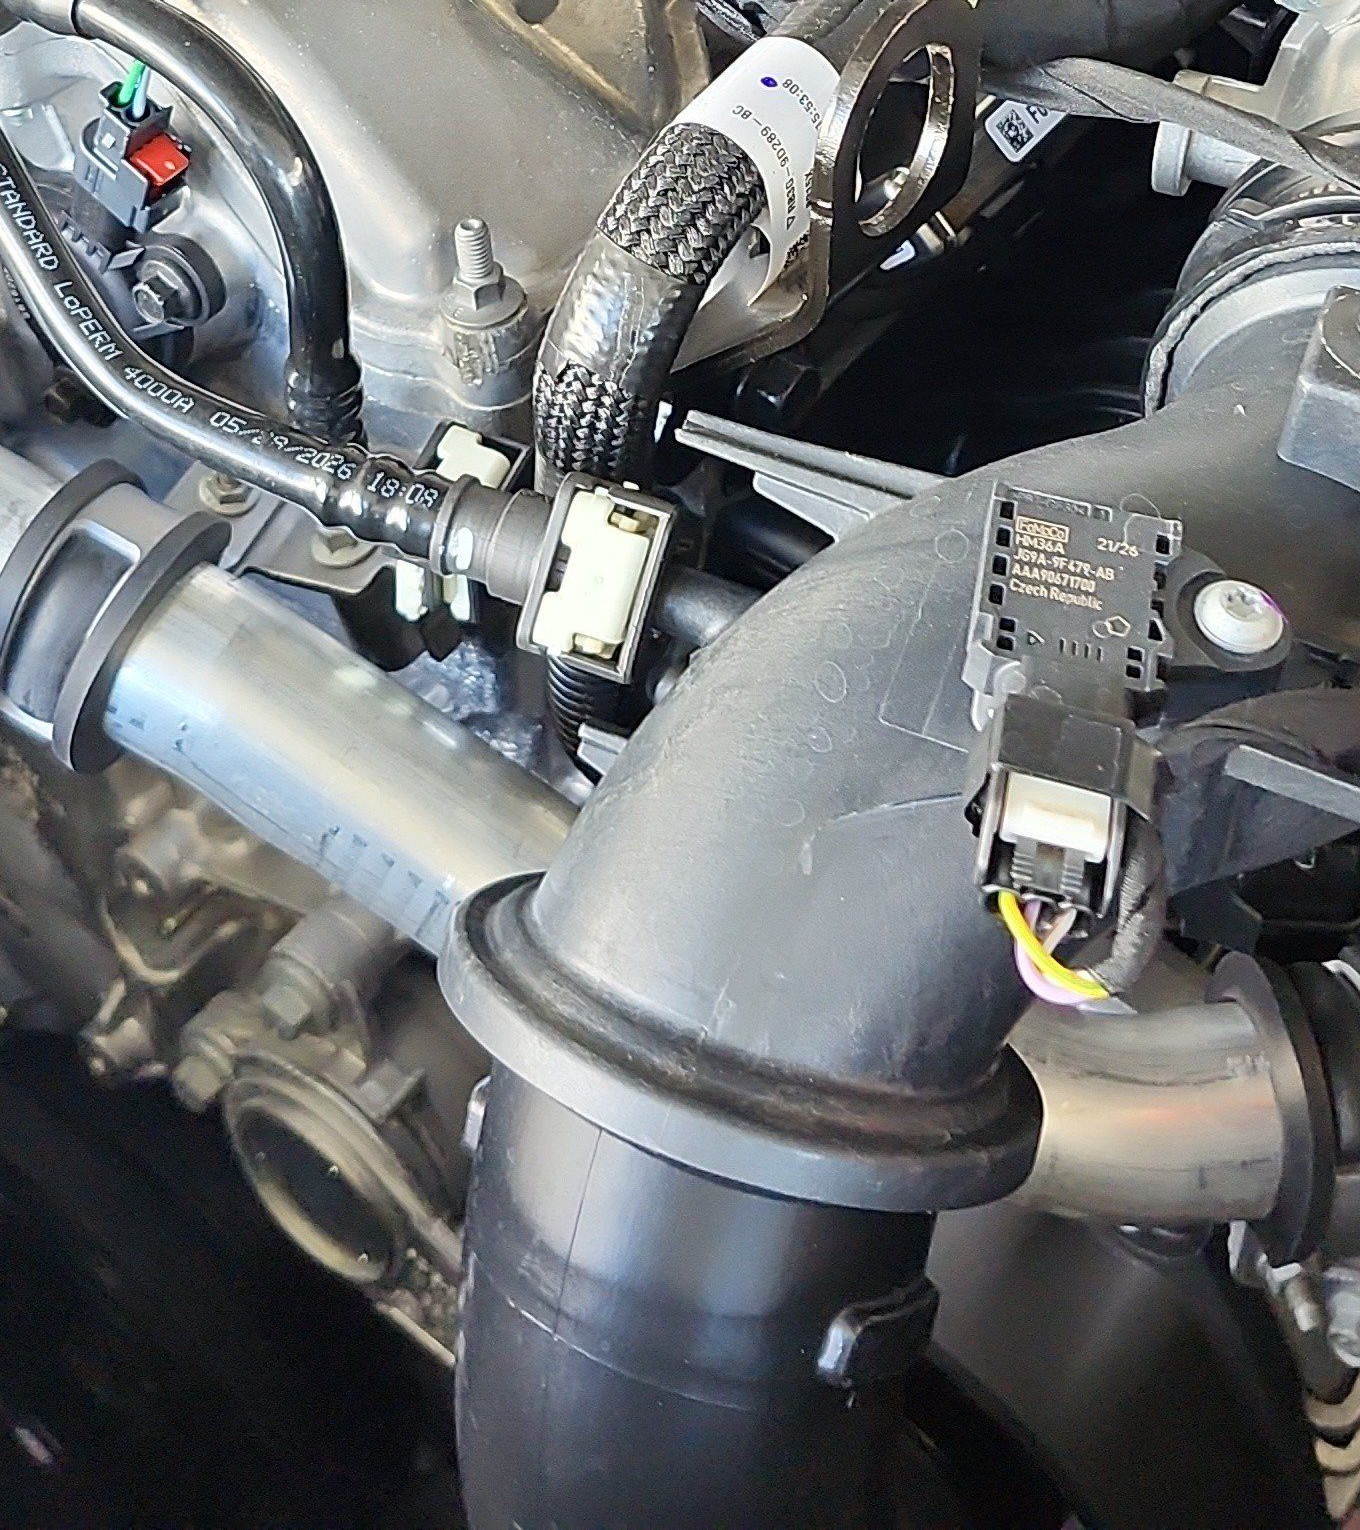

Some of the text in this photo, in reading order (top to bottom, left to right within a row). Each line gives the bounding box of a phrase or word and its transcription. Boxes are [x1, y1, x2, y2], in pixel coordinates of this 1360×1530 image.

[53, 281, 124, 361] LoPERM
[123, 366, 195, 413] 4000A
[1019, 521, 1066, 539] FoMoCo
[1015, 533, 1065, 555] HM36A
[1097, 537, 1139, 558] 21/26
[1010, 578, 1103, 611] Czech Republic
